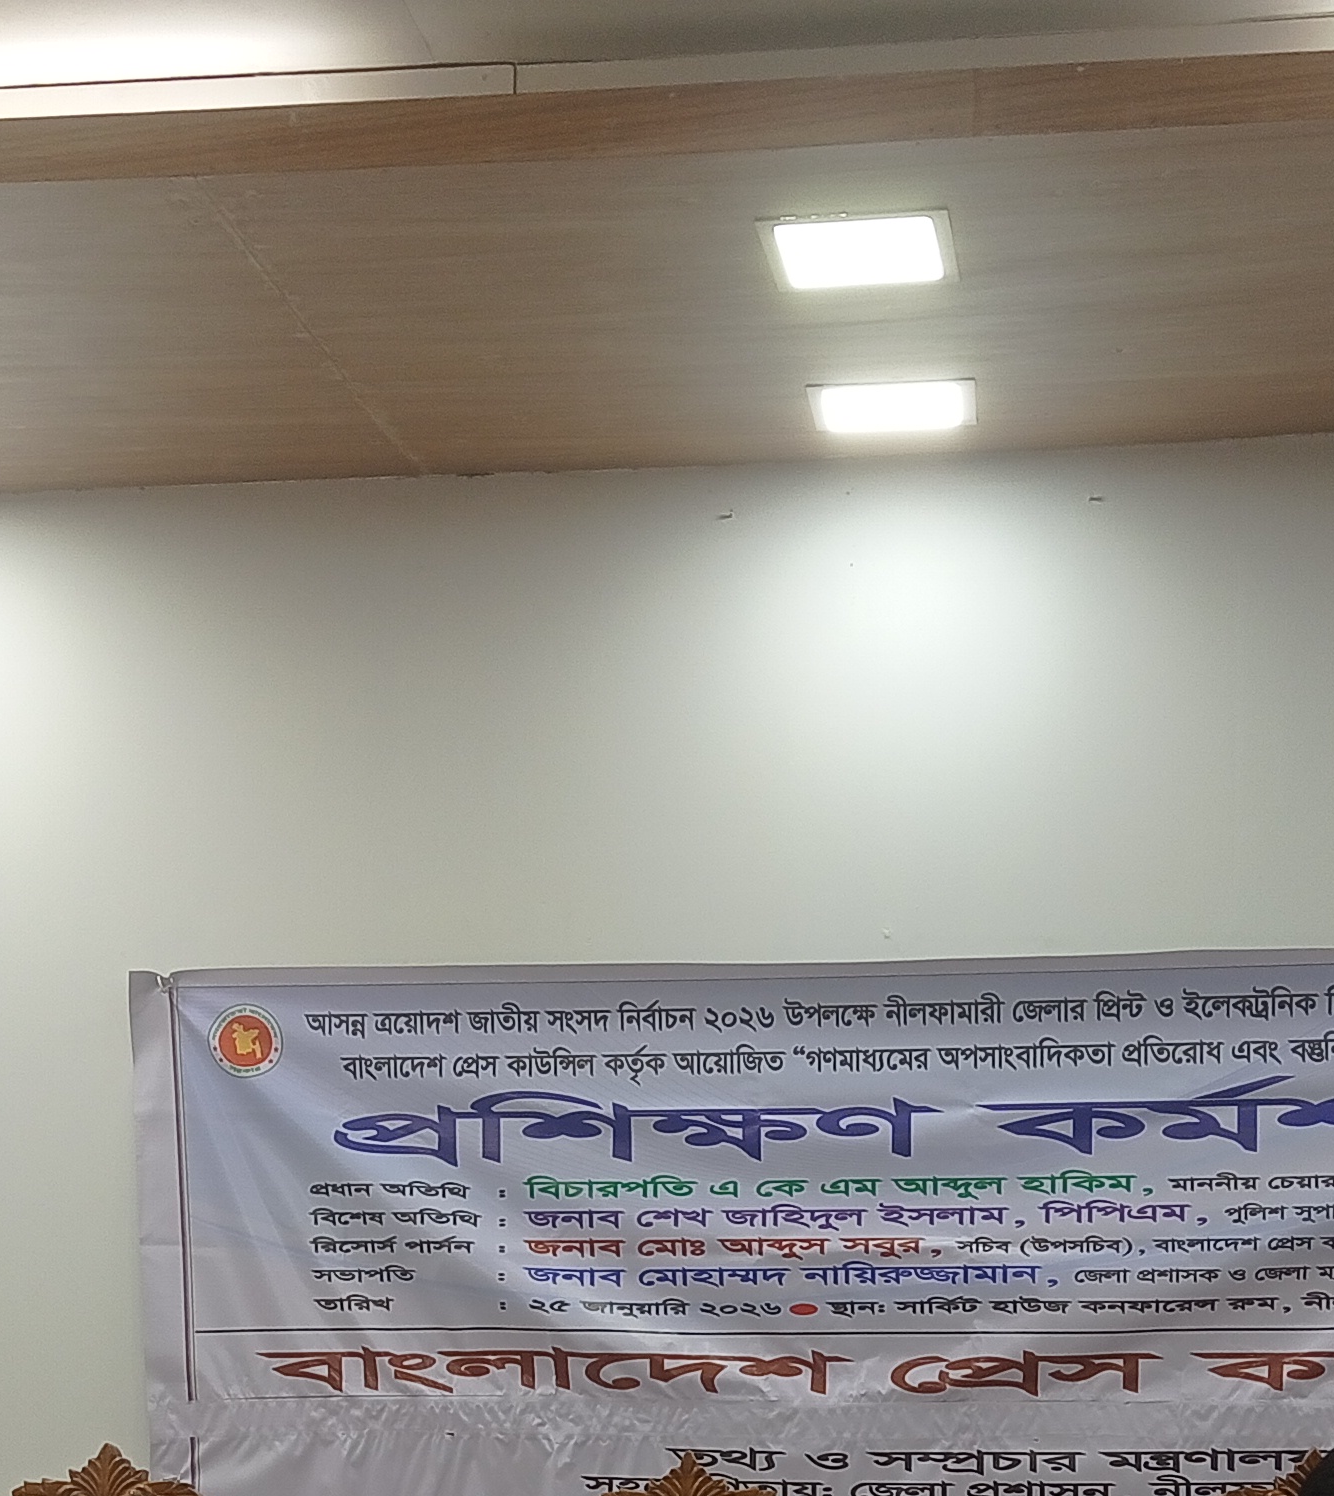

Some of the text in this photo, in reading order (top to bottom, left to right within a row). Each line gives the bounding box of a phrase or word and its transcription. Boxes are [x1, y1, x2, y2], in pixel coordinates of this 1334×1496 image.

[303, 1011, 369, 1040] আসন্ন
[372, 1008, 463, 1036] ত্রয়োদশ
[465, 1001, 541, 1035] জাতীয়
[544, 1009, 613, 1035] সংসদ
[615, 999, 698, 1033] নির্বাচন
[703, 1006, 775, 1034] ২০২৬
[781, 997, 879, 1028] উপলক্ষে
[882, 991, 1006, 1028] নীলফামারী
[1012, 996, 1089, 1023] জেলার
[1092, 989, 1148, 1023] প্রিন্ট
[1153, 997, 1174, 1018] ও
[339, 1053, 448, 1081] বাংলাদেশ
[452, 1053, 501, 1079] প্রেস
[504, 1046, 598, 1078] কাউন্সিল
[601, 1044, 668, 1084] কর্তৃক
[671, 1043, 787, 1076] আয়োজিত
[935, 1036, 1117, 1071] অপসাংবাদিকতা
[1121, 1034, 1225, 1068] প্রতিরোধ
[1231, 1040, 1282, 1065] এবং
[333, 1090, 944, 1168] প্রশিক্ষণ
[309, 1182, 374, 1198] প্রধান
[378, 1180, 471, 1200] অতিথি
[521, 1174, 699, 1200] বিচারপতি
[709, 1180, 739, 1199] এ
[755, 1179, 810, 1198] কে
[820, 1178, 883, 1198] এম
[890, 1175, 1009, 1198] আব্দুল
[1167, 1171, 1261, 1192] মাননীয়
[308, 1207, 387, 1227] বিশেষ
[391, 1207, 483, 1228] অতিথি
[522, 1208, 626, 1230] জনাব
[636, 1207, 715, 1228] শেখ
[720, 1203, 869, 1231] জাহিদুল
[1224, 1202, 1290, 1225] পুলিশ
[308, 1235, 398, 1254] রিসোর্স
[404, 1235, 476, 1255] পার্সন
[522, 1237, 627, 1258] জনাব
[637, 1236, 706, 1257] মোঃ
[716, 1236, 831, 1261] আব্দুস
[955, 1236, 1013, 1254] সচিব
[1151, 1236, 1262, 1254] বাংলাদেশ
[1267, 1235, 1316, 1252] প্রেস
[310, 1264, 417, 1284] সভাপতি
[522, 1266, 628, 1288] জনাব
[638, 1266, 792, 1288] মোহাম্মদ
[1074, 1268, 1132, 1284] জেলা
[1136, 1267, 1222, 1284] প্রশাসক
[1227, 1268, 1247, 1282] ও
[1254, 1265, 1312, 1282] জেলা
[312, 1293, 395, 1312] তারিখ
[528, 1298, 572, 1315] ২৫
[579, 1297, 692, 1318] জানুয়ারি
[698, 1302, 782, 1318] ২০২৬
[892, 1295, 984, 1315] সার্কিট
[988, 1295, 1073, 1315] হাউজ
[1077, 1298, 1221, 1315] কনফারেন্স
[255, 1345, 855, 1395] বাংলাদেশ
[890, 1349, 1164, 1398] প্রেস
[804, 1452, 849, 1471] ও
[865, 1448, 1087, 1477] সম্প্রচার
